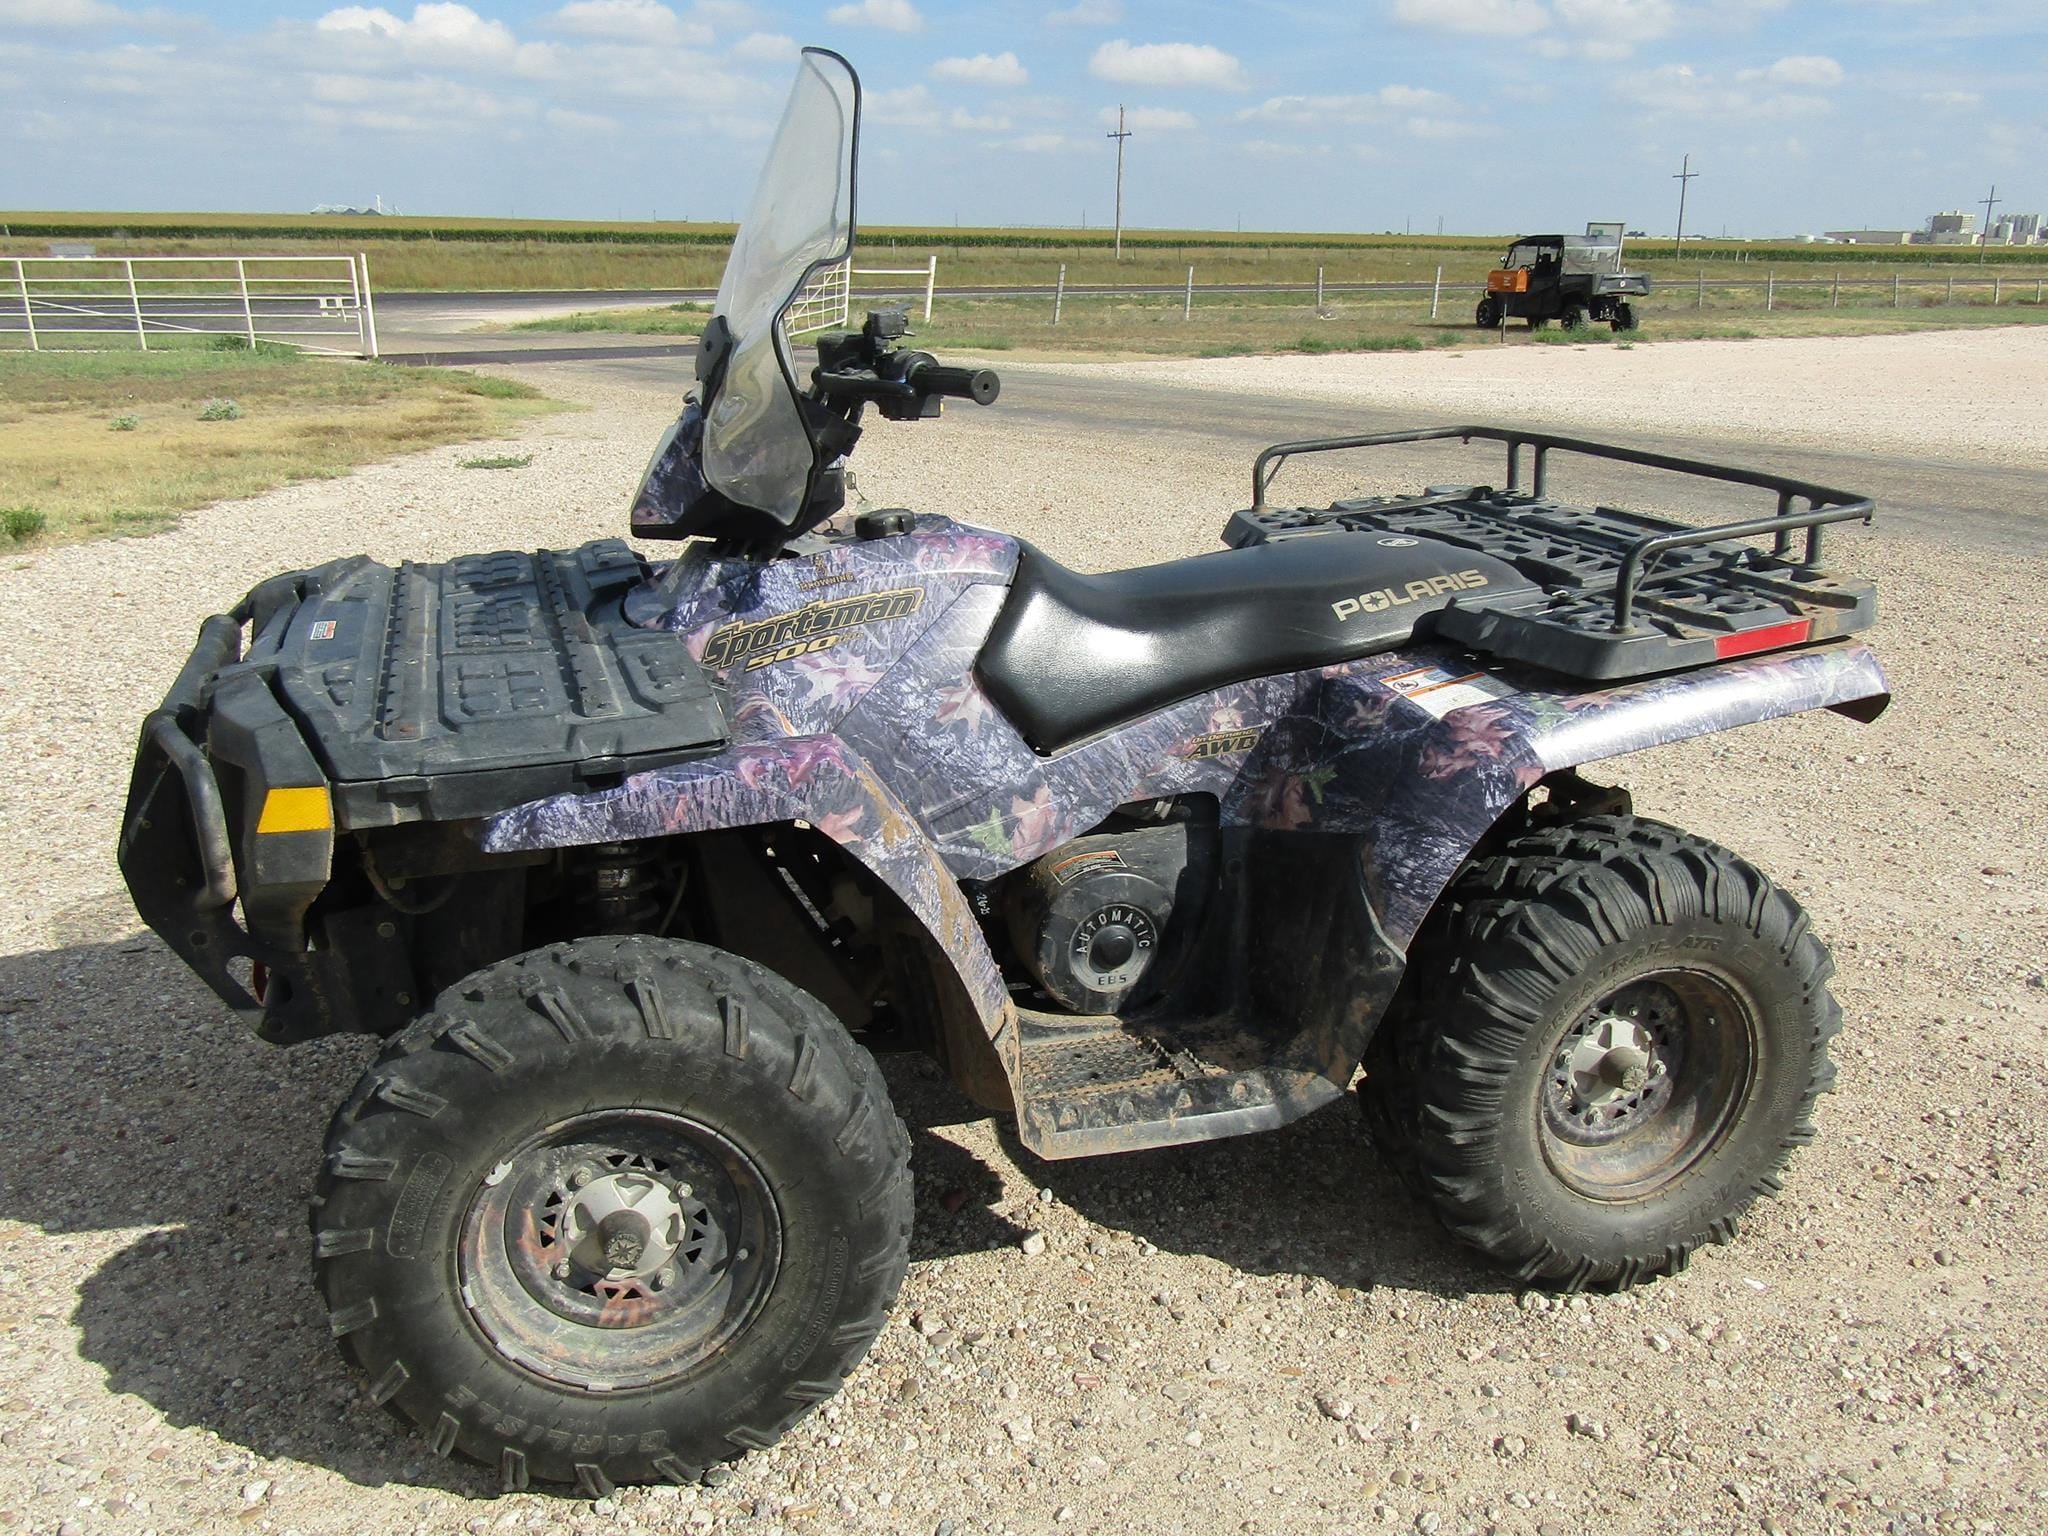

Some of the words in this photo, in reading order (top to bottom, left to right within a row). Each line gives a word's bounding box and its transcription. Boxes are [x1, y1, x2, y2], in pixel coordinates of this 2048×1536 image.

[1331, 569, 1488, 621] POLARIS
[702, 589, 923, 669] Sportsman
[744, 633, 841, 672] 500
[1076, 910, 1151, 954] AUTOMATIC
[1098, 973, 1127, 985] EBS
